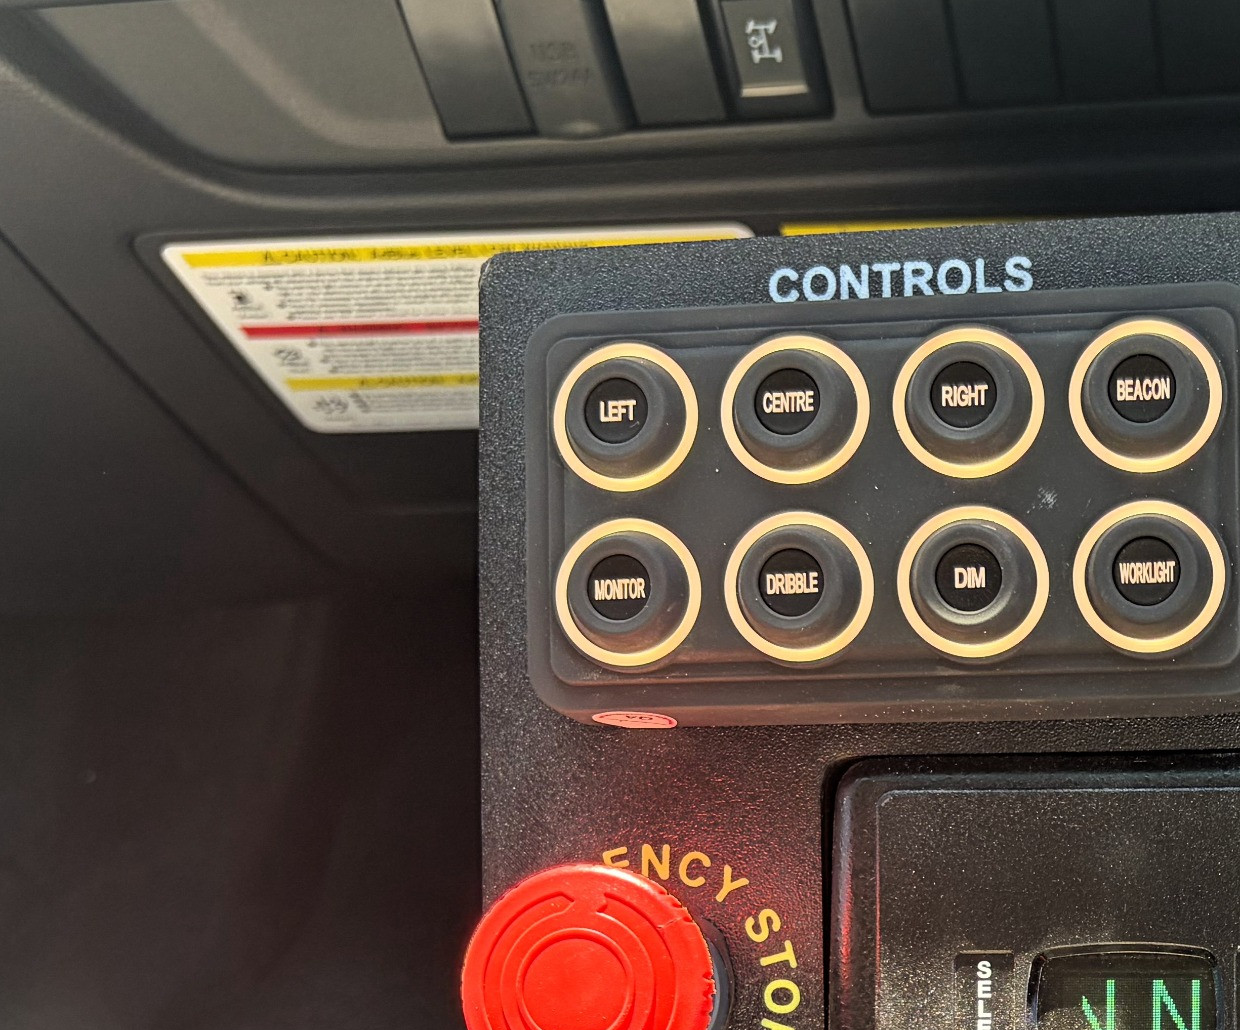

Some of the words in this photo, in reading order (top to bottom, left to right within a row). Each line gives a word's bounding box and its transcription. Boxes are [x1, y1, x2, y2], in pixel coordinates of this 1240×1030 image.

[768, 256, 1035, 303] CONTROLS
[941, 384, 989, 407] RIGHT
[1116, 377, 1171, 401] BEACON
[599, 400, 637, 423] LEFT
[762, 390, 815, 414] CENTRE
[766, 572, 819, 595] DRIBBLE
[954, 566, 986, 589] DIM
[1118, 560, 1176, 584] WORKLIGHT
[594, 578, 646, 601] MONITOR
